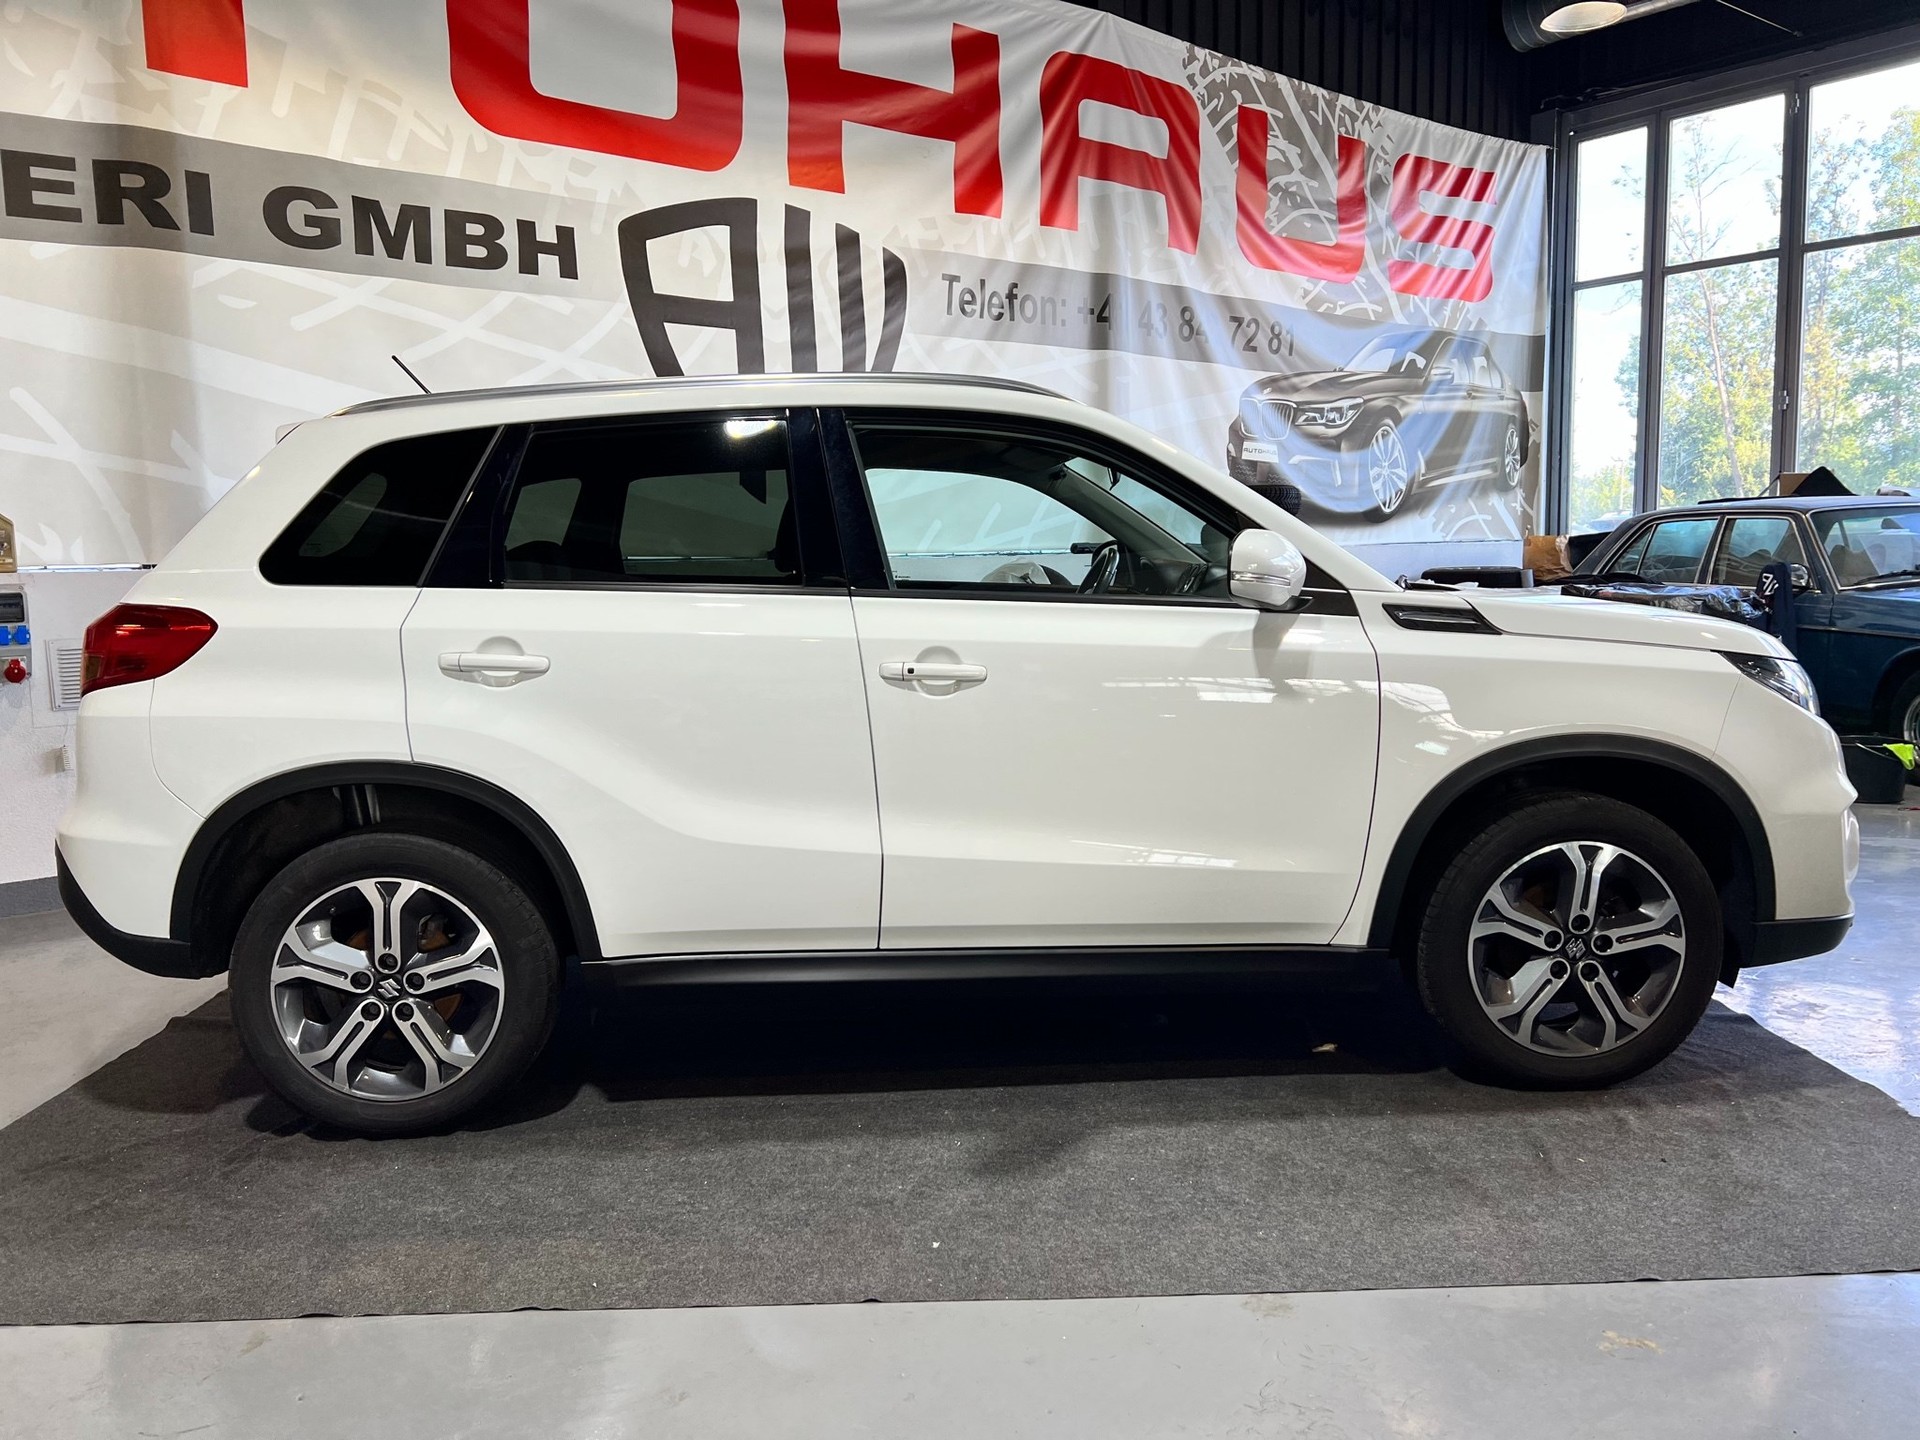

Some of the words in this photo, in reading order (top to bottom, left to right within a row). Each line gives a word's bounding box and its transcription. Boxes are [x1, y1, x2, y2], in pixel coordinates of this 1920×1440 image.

[1, 148, 215, 236] ERI
[262, 185, 579, 281] GMBH
[941, 273, 1067, 327] Telefon:
[1138, 300, 1168, 339] 43
[1228, 315, 1260, 353] 72
[1268, 320, 1295, 357] 81
